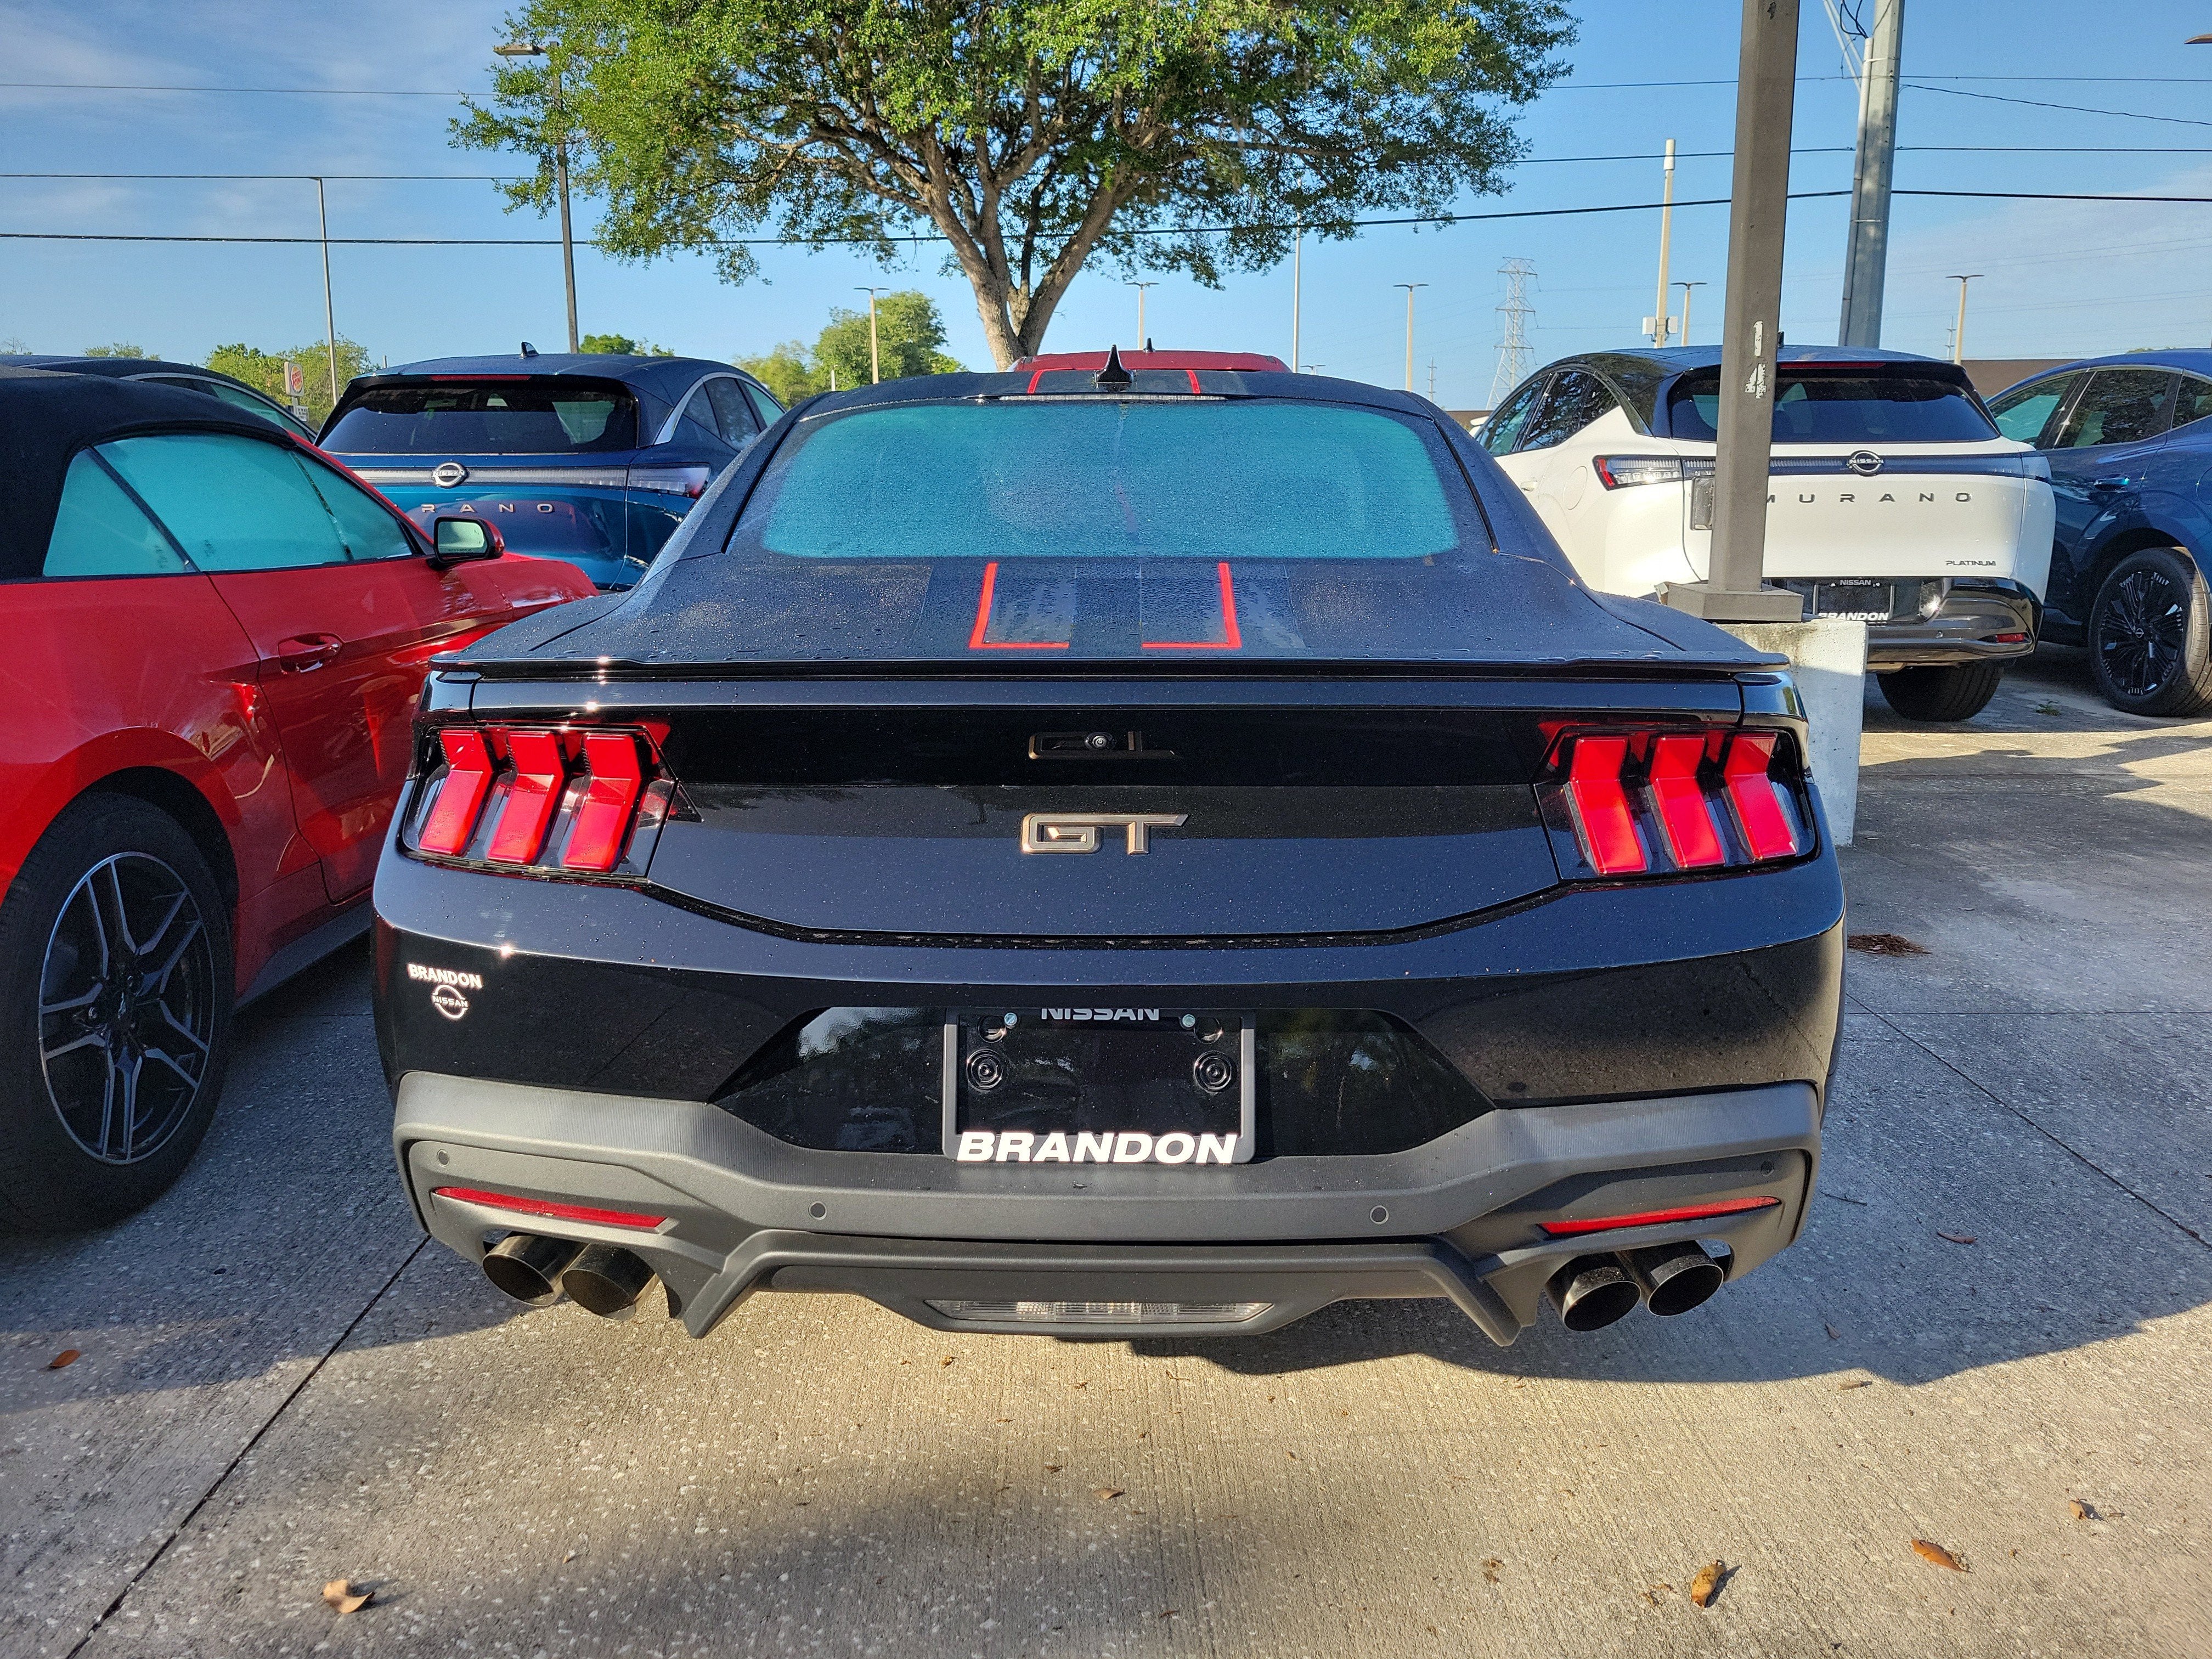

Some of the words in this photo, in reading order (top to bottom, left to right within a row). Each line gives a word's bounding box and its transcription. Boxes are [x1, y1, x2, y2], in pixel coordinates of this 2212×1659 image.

[1818, 612, 1889, 620] BRANDON
[1021, 812, 1188, 854] GT
[407, 963, 484, 989] BRANDON
[432, 995, 469, 1008] NISSAN
[1041, 1008, 1159, 1020] NISSAN
[957, 1131, 1238, 1164] BRANDON
